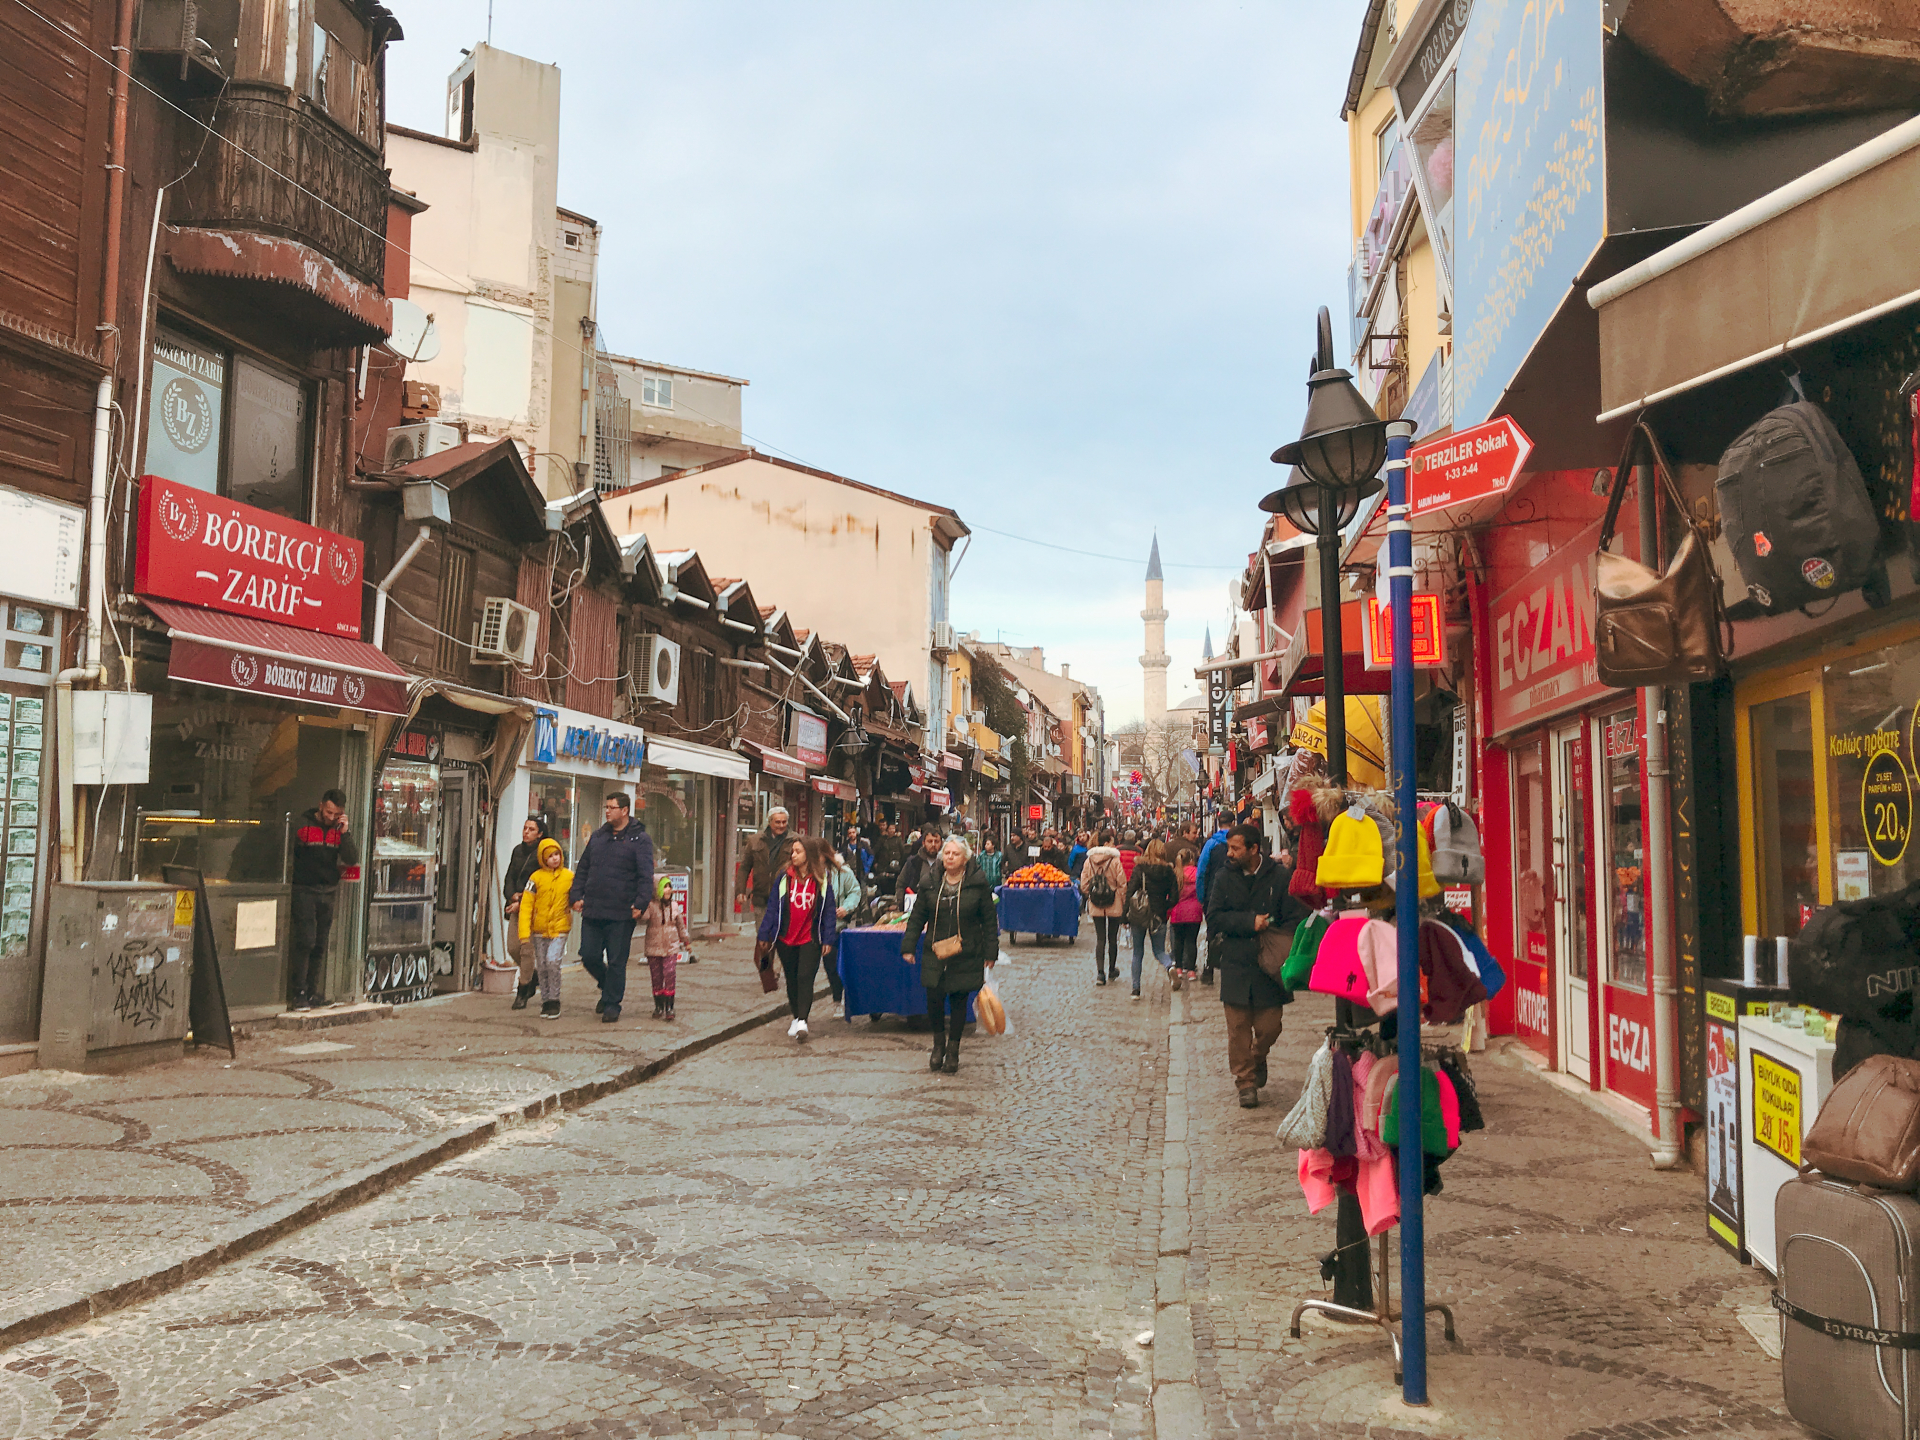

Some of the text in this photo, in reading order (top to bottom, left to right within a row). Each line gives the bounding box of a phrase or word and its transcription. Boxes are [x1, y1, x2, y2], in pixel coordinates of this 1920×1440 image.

[1425, 430, 1508, 471] TERZİLER Sokak
[1445, 462, 1478, 480] 1-33 2-44
[202, 510, 323, 580] BÖREKÇİ
[222, 568, 303, 616] ZARİF
[1497, 545, 1598, 691] ECZAN
[264, 660, 307, 696] BÖREKÇİ
[309, 671, 338, 696] ZARİF
[1211, 671, 1223, 744] HOTEL
[1874, 802, 1898, 841] 20
[1758, 1064, 1781, 1089] BÜYÜK
[1782, 1077, 1798, 1098] ODA
[1762, 1087, 1795, 1117] KOKULARI
